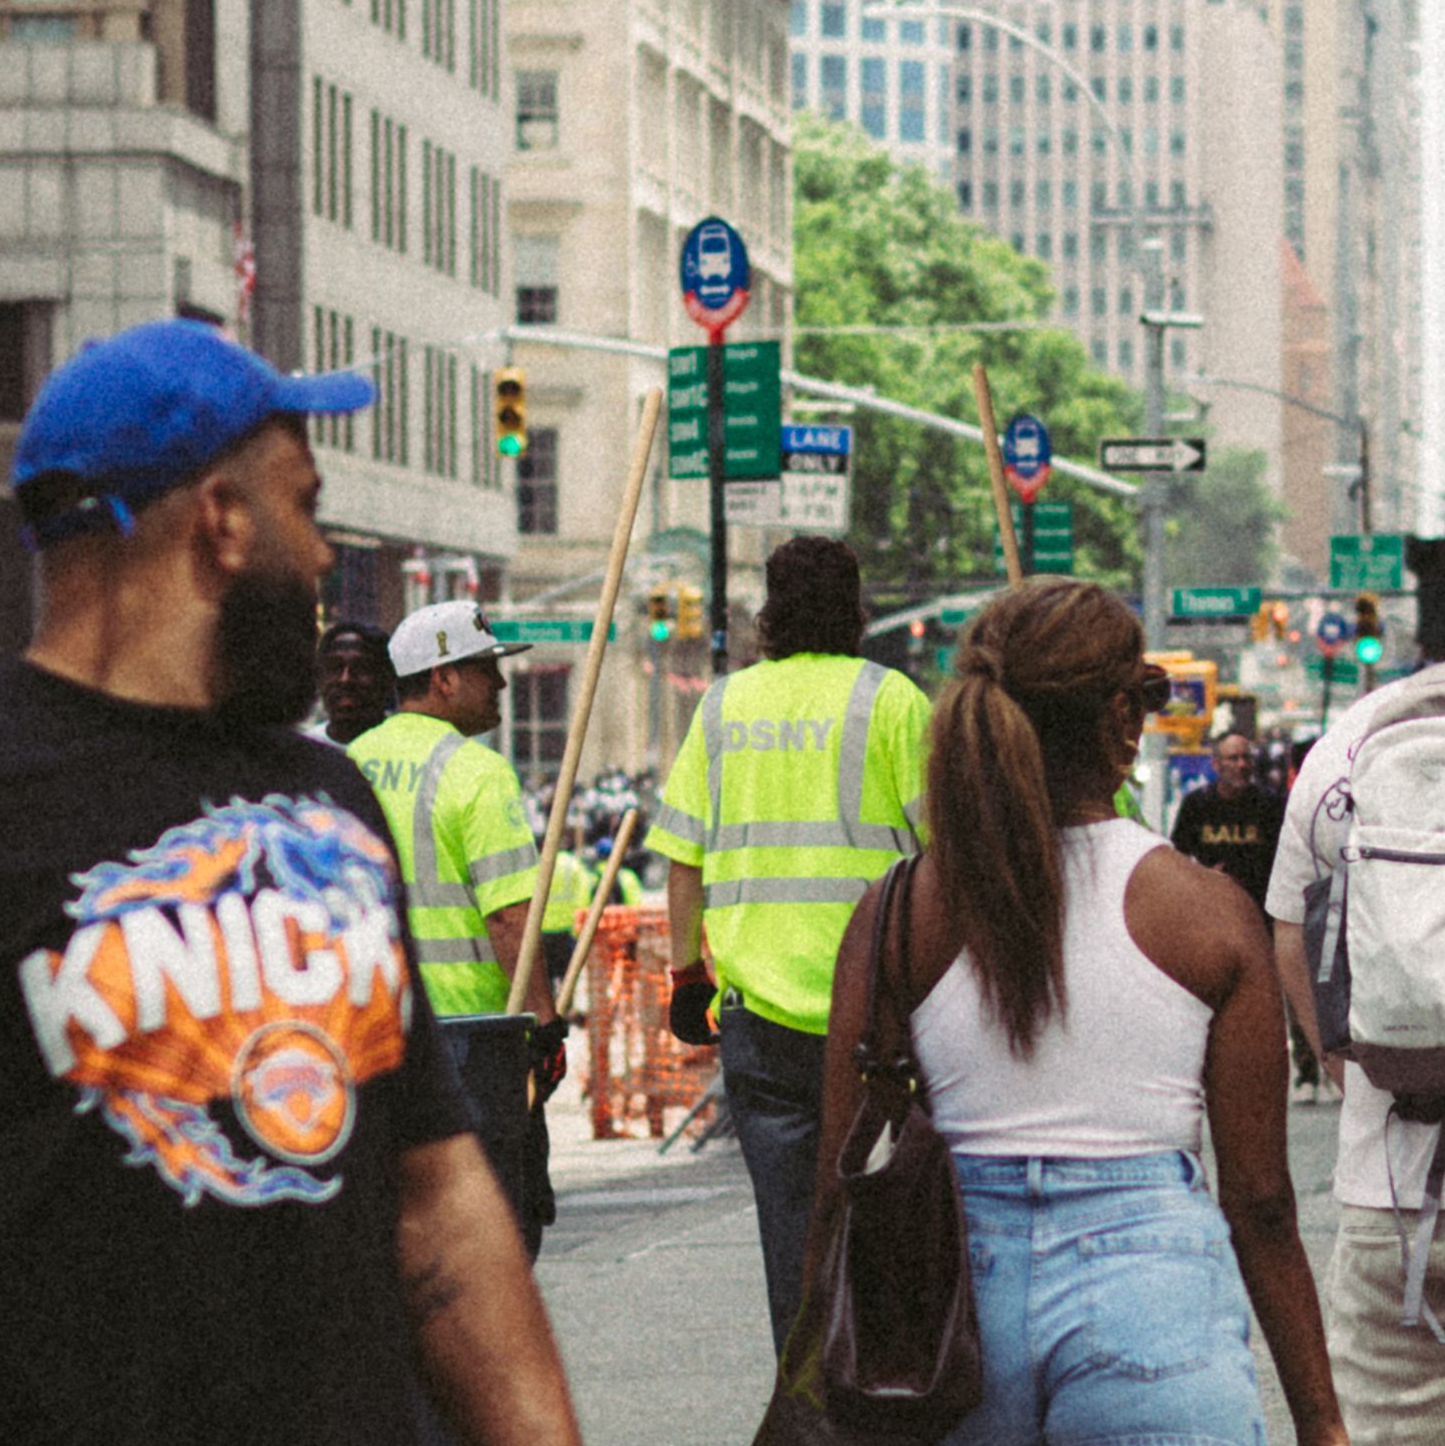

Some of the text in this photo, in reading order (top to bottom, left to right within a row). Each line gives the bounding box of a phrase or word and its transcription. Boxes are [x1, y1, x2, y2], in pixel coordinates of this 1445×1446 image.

[788, 428, 843, 450] LANE
[787, 454, 841, 472] ONLY
[722, 717, 836, 754] DSNY
[17, 880, 412, 1078] KNICK
